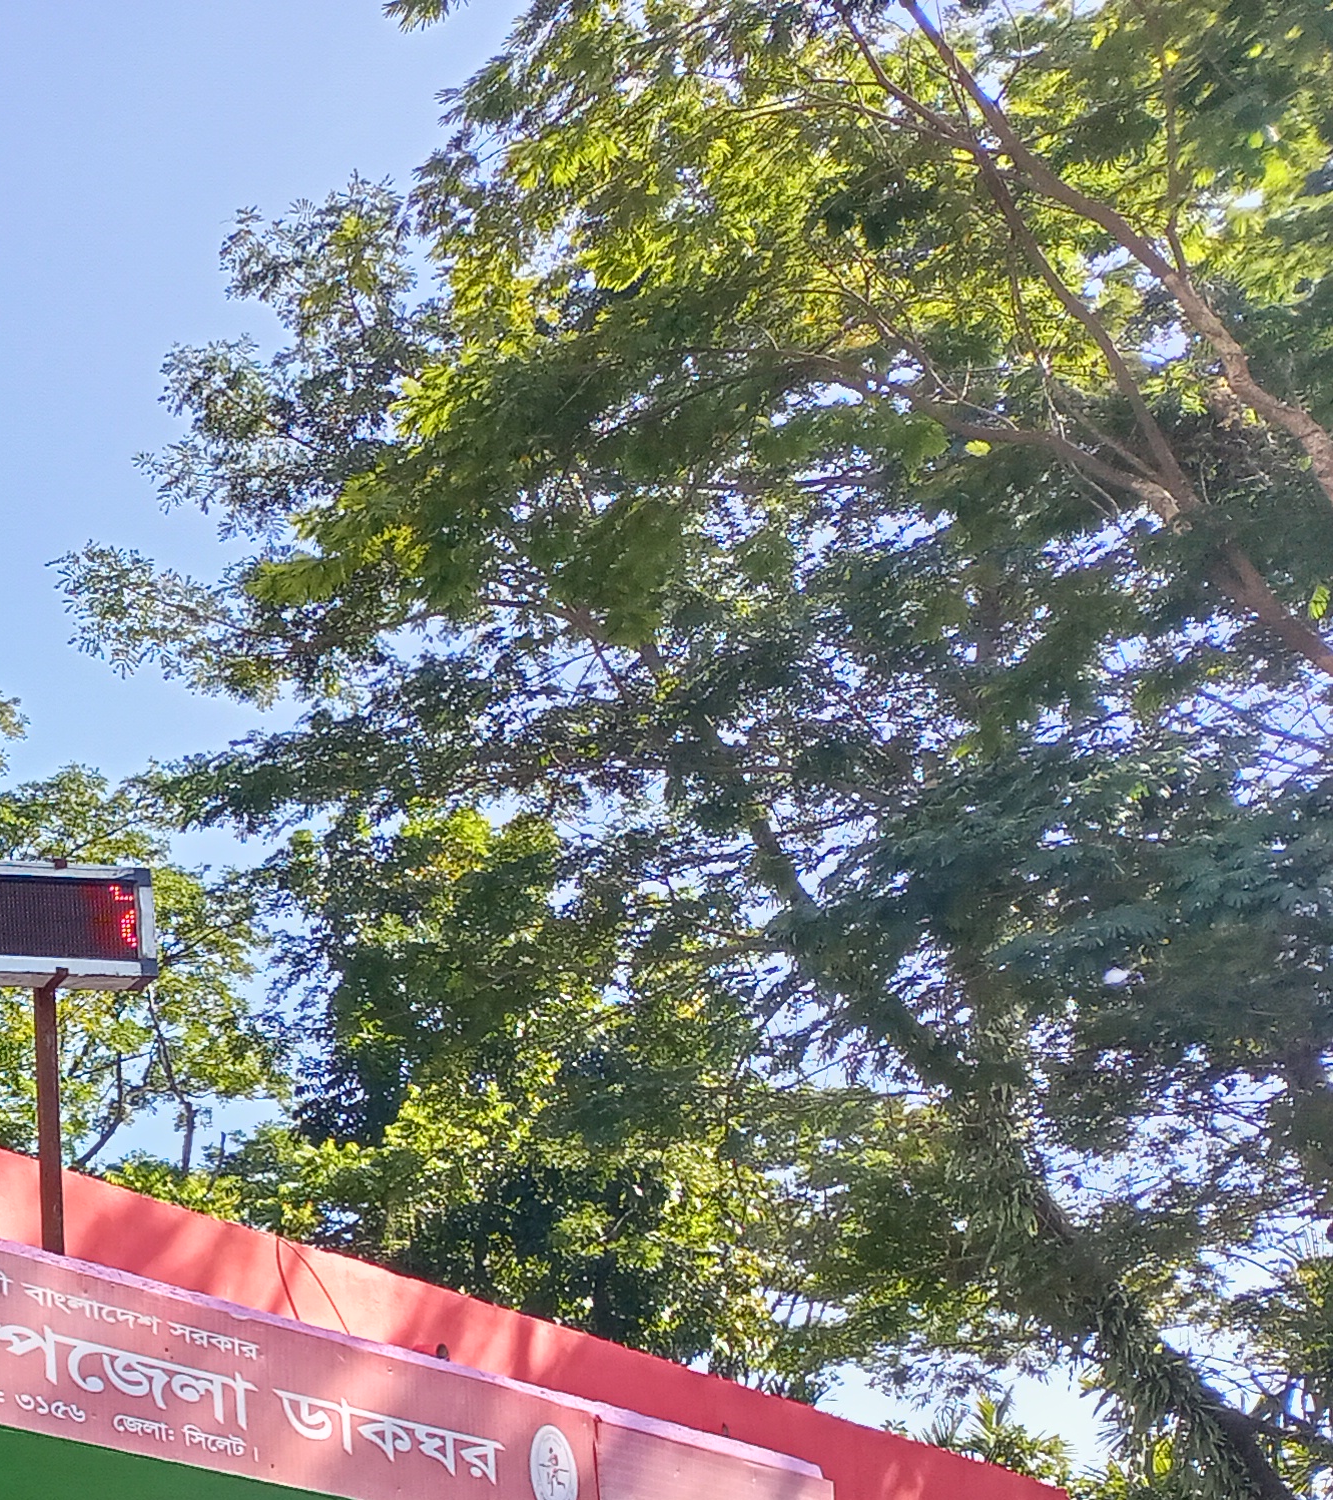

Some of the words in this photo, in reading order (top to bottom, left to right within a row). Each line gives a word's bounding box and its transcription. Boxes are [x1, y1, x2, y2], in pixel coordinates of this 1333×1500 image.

[20, 1281, 162, 1337] বাংলাদেশ
[167, 1319, 261, 1361] সরকার
[14, 1393, 87, 1424] ৩১৫৬
[272, 1384, 507, 1486] ডাকঘর
